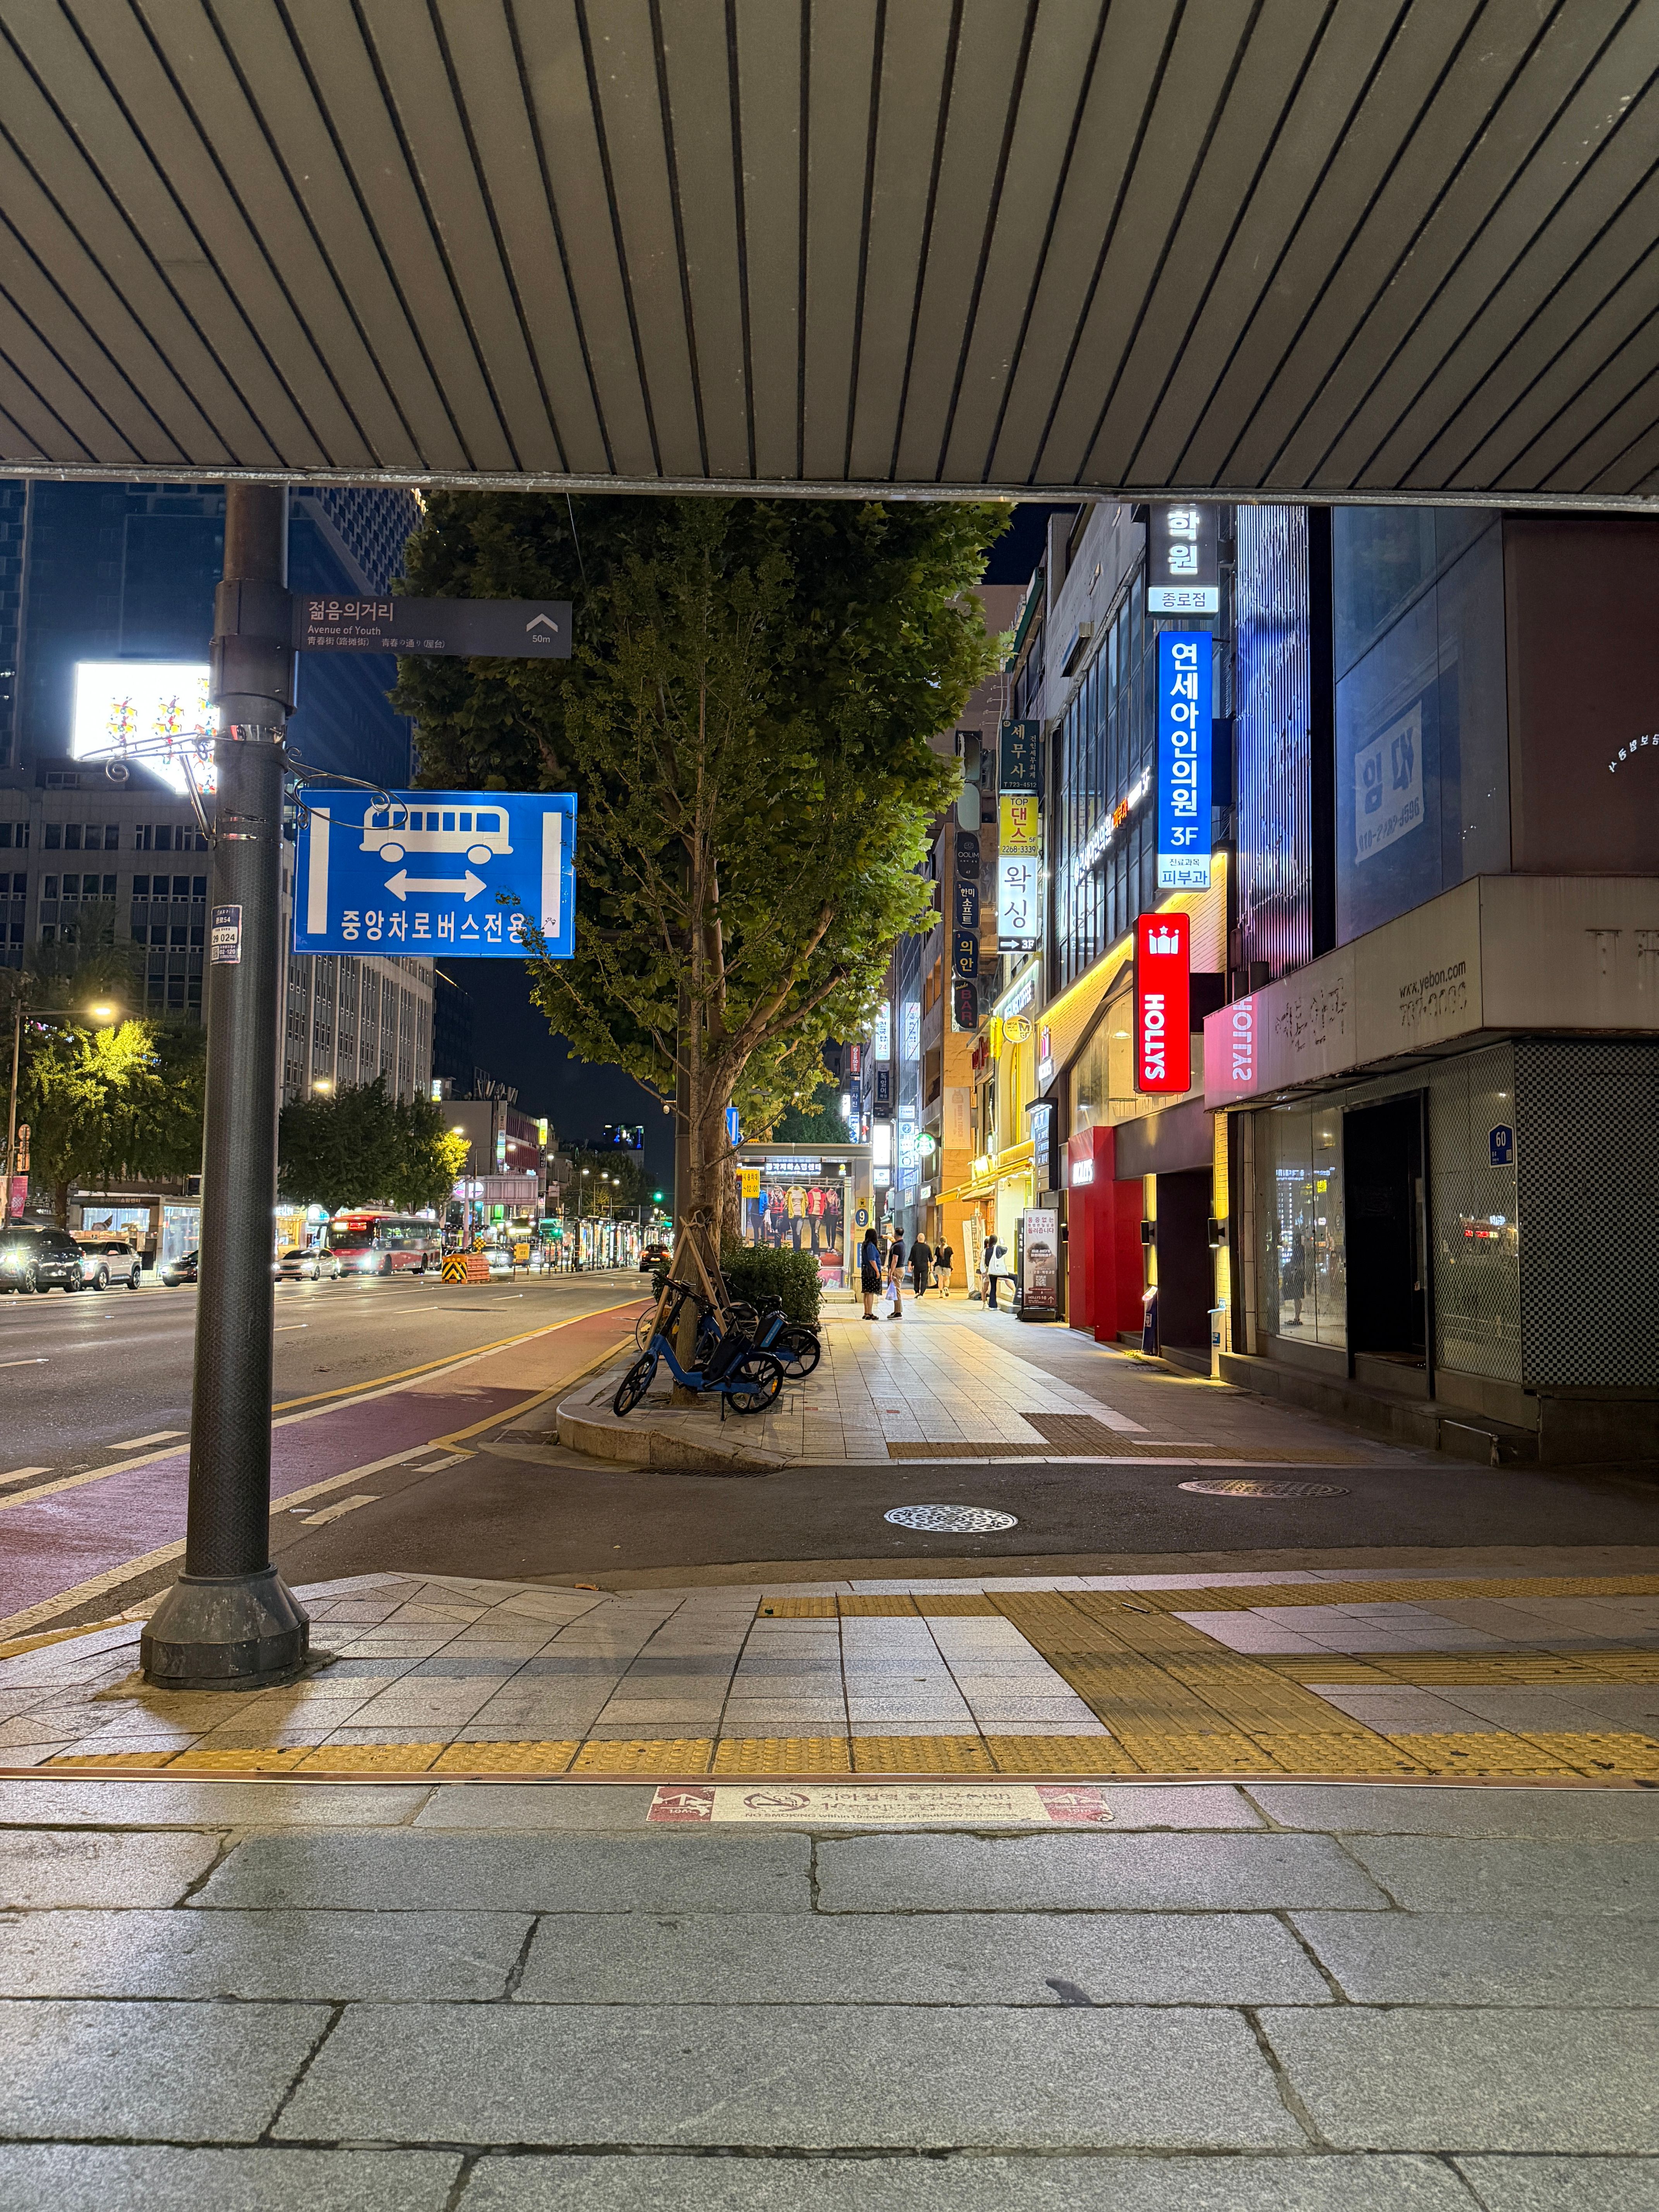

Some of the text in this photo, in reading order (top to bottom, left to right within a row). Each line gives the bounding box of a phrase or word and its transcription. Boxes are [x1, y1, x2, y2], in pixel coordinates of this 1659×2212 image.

[1162, 592, 1205, 607] 종로점
[309, 601, 393, 622] 젊음의거리
[308, 625, 381, 635] Avenue of Youth
[532, 635, 550, 643] 50m
[1170, 643, 1199, 817] 연세아인의원
[1010, 724, 1026, 779] 세무사
[1010, 798, 1029, 806] TOP
[1010, 807, 1027, 843] 댄스
[1171, 826, 1199, 846] 3F
[1170, 858, 1200, 866] 진료과목
[1162, 871, 1207, 886] 피부과
[960, 888, 975, 898] 한미
[1004, 864, 1032, 929] 왁싱
[962, 898, 972, 924] 소프트
[341, 909, 528, 944] 중앙차로버스전용
[220, 933, 235, 942] 024
[1022, 939, 1035, 949] 3F
[960, 940, 974, 972] 의안
[961, 989, 972, 1021] BAR
[1144, 994, 1165, 1080] HOLLYS
[852, 1093, 859, 1108] 사진
[1496, 1131, 1506, 1147] 60
[859, 1211, 865, 1222] 9
